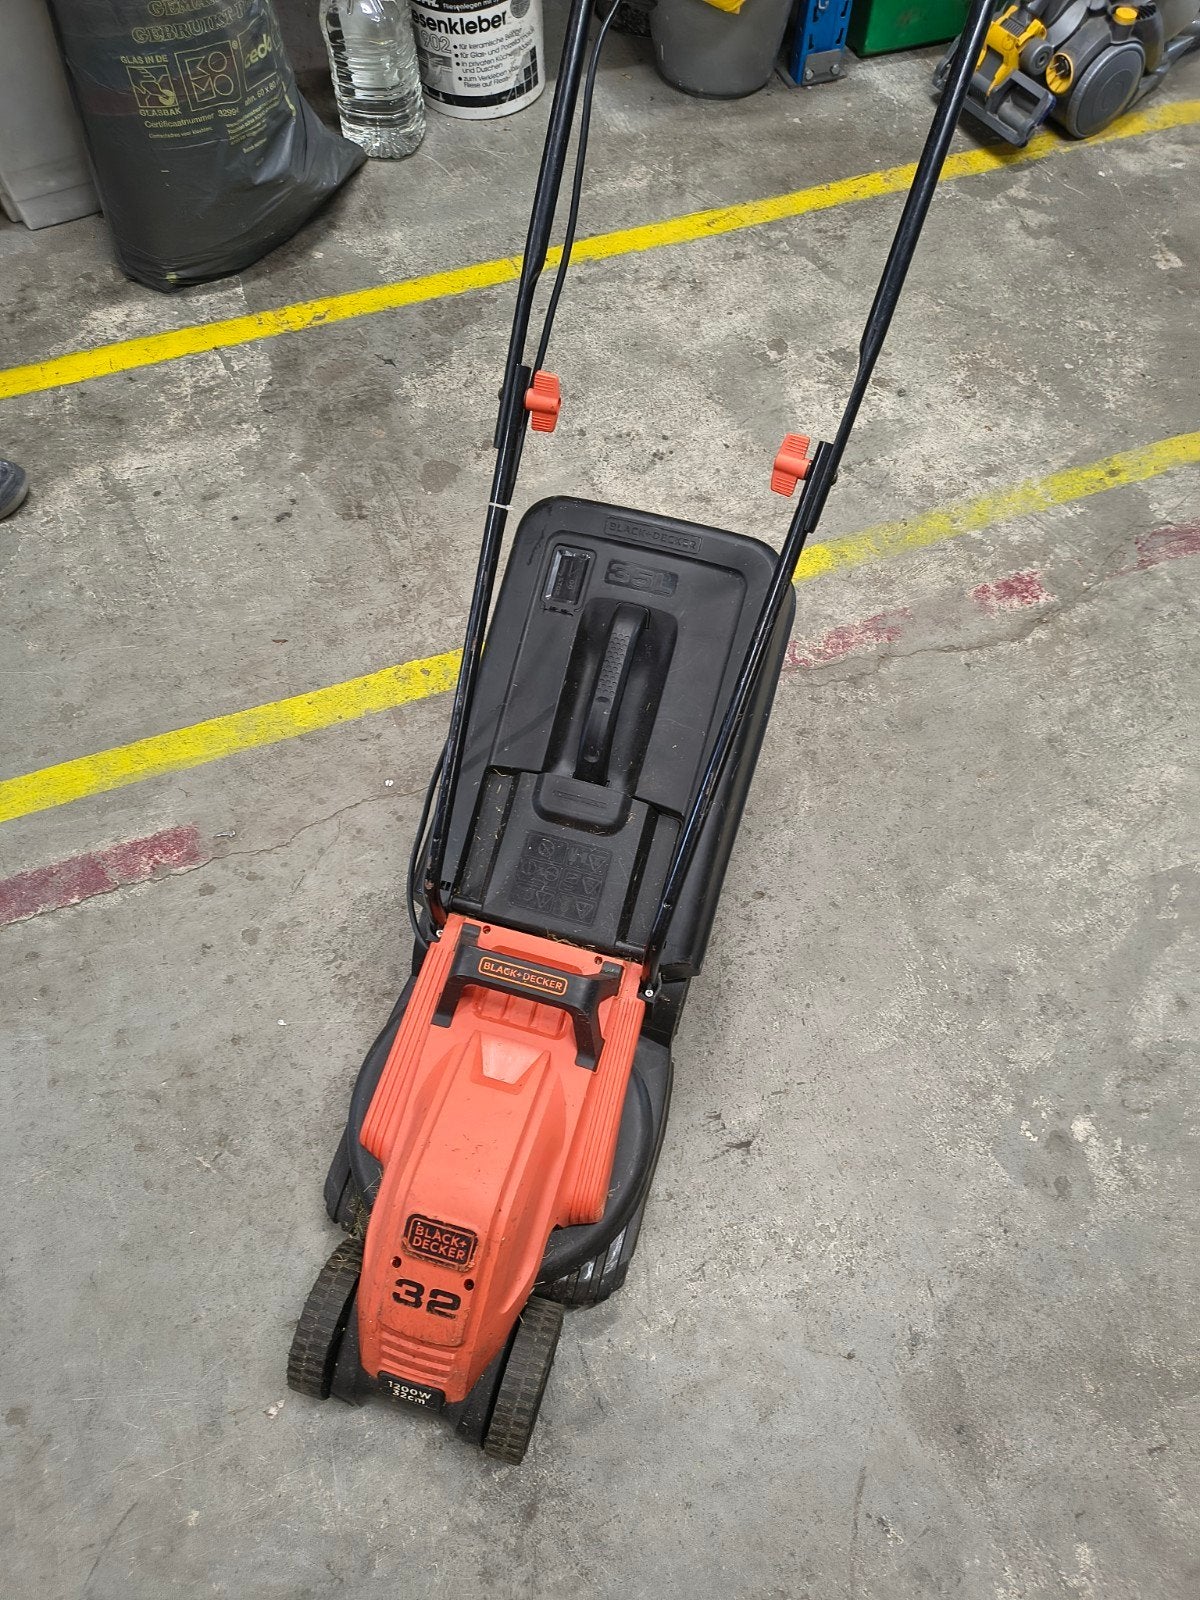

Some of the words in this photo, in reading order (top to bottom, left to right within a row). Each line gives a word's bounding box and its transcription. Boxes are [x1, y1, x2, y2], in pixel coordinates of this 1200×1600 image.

[131, 8, 233, 44] GEBRUIKT
[120, 55, 144, 64] GLAS
[144, 55, 154, 64] IN
[155, 54, 169, 63] DE
[476, 62, 503, 73] Duschen
[140, 107, 182, 117] GLASBAK
[415, 1225, 467, 1249] BLACK+
[412, 1236, 465, 1261] DECKER
[392, 1278, 462, 1320] 32
[388, 1380, 432, 1400] 1200W
[392, 1389, 426, 1405] 32cm
